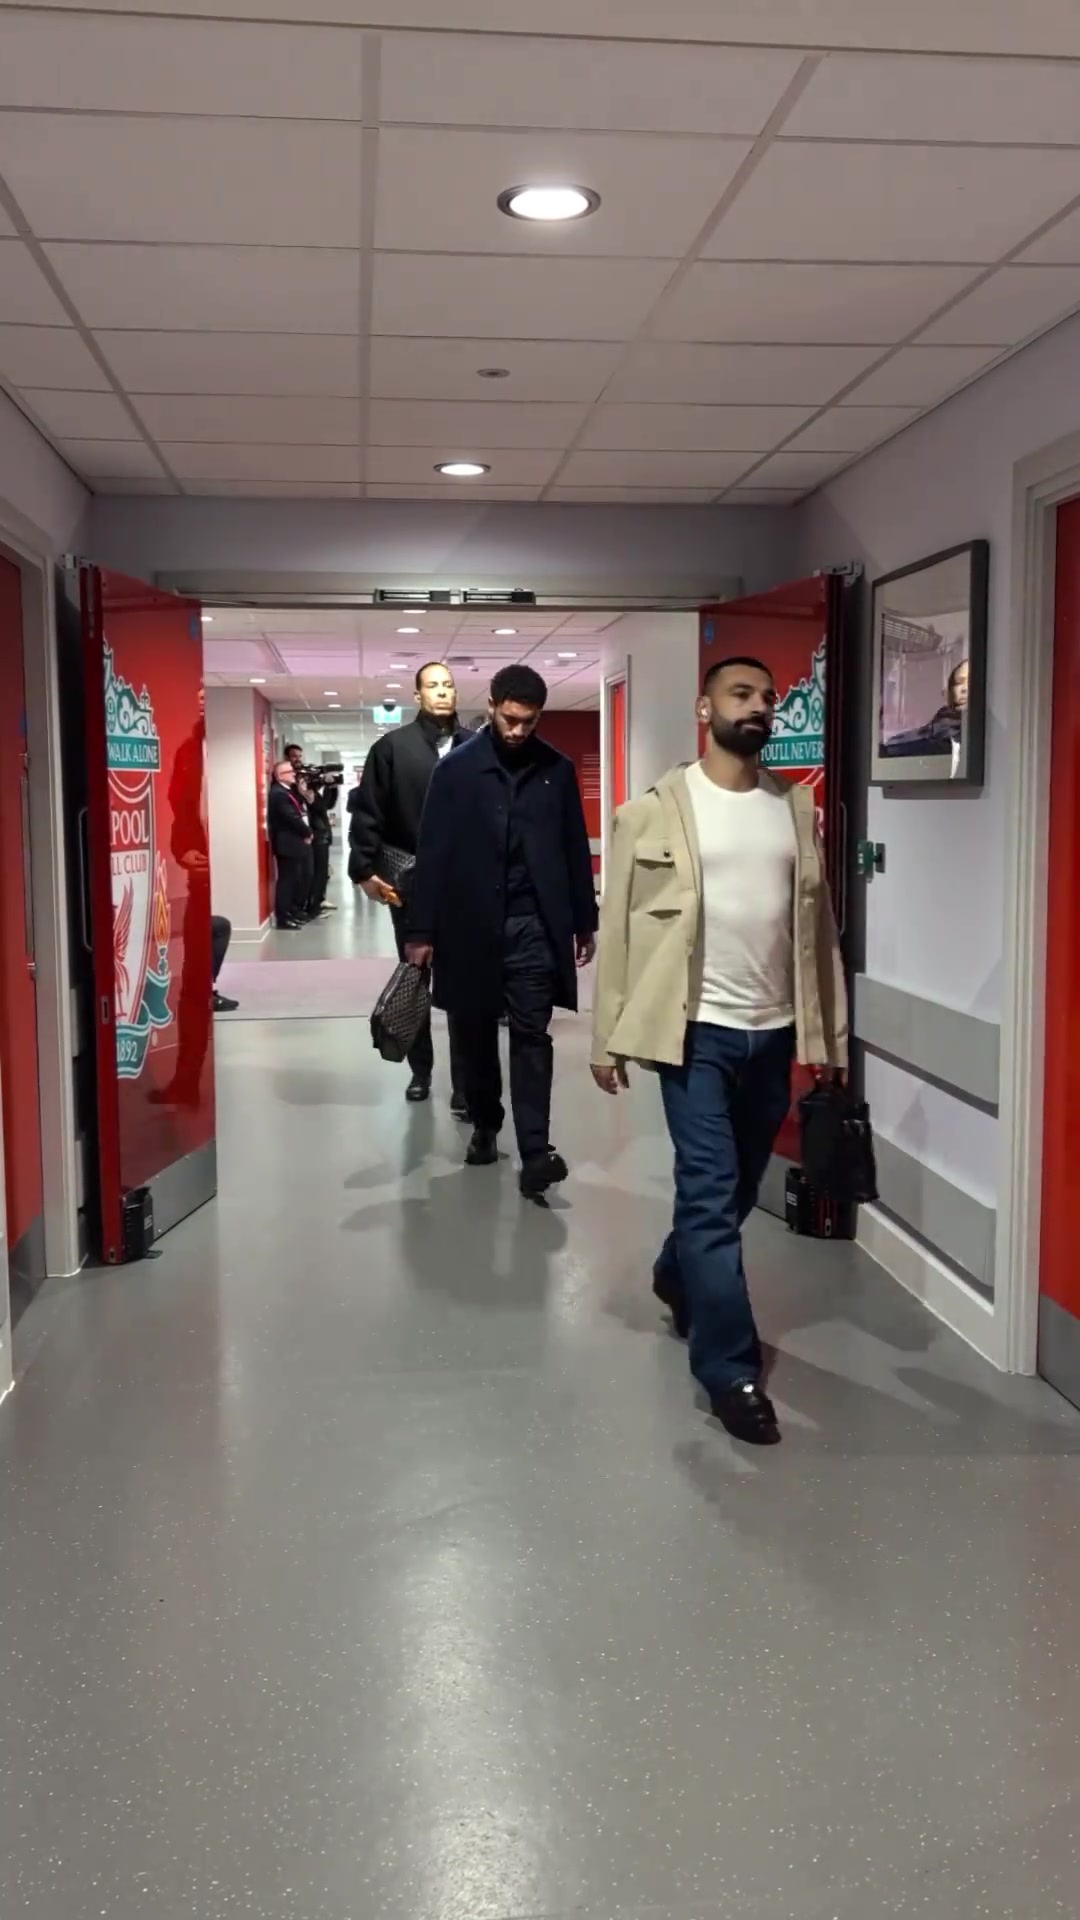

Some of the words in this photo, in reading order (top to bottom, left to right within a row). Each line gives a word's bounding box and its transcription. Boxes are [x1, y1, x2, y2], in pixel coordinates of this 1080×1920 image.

[107, 742, 131, 761] WALK
[132, 744, 158, 763] ALONE
[791, 741, 824, 760] NEVER
[123, 854, 147, 874] CLUB
[116, 1041, 137, 1062] 1892
